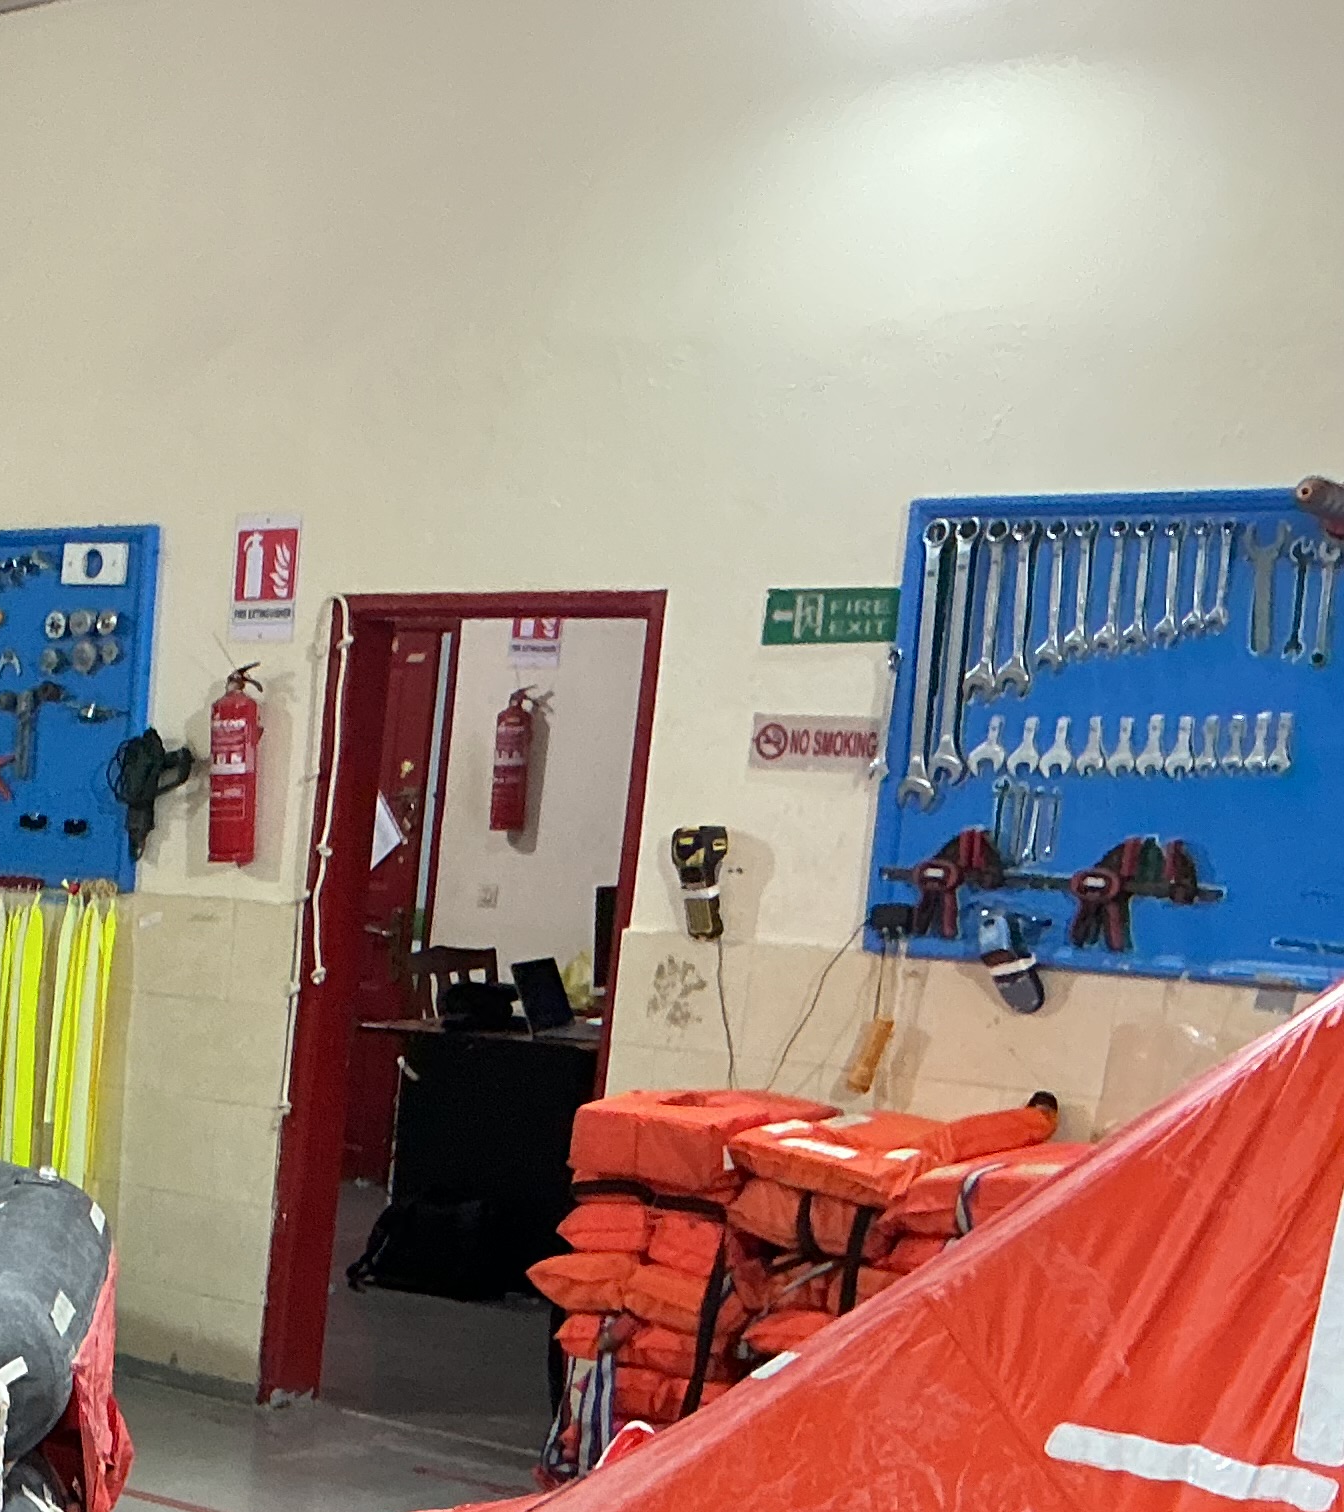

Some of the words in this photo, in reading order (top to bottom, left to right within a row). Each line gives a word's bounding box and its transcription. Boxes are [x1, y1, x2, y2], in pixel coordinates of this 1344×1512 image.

[830, 599, 891, 615] FIRE
[828, 619, 886, 636] EXIT
[789, 729, 810, 755] NO
[813, 730, 878, 758] SMOKING
